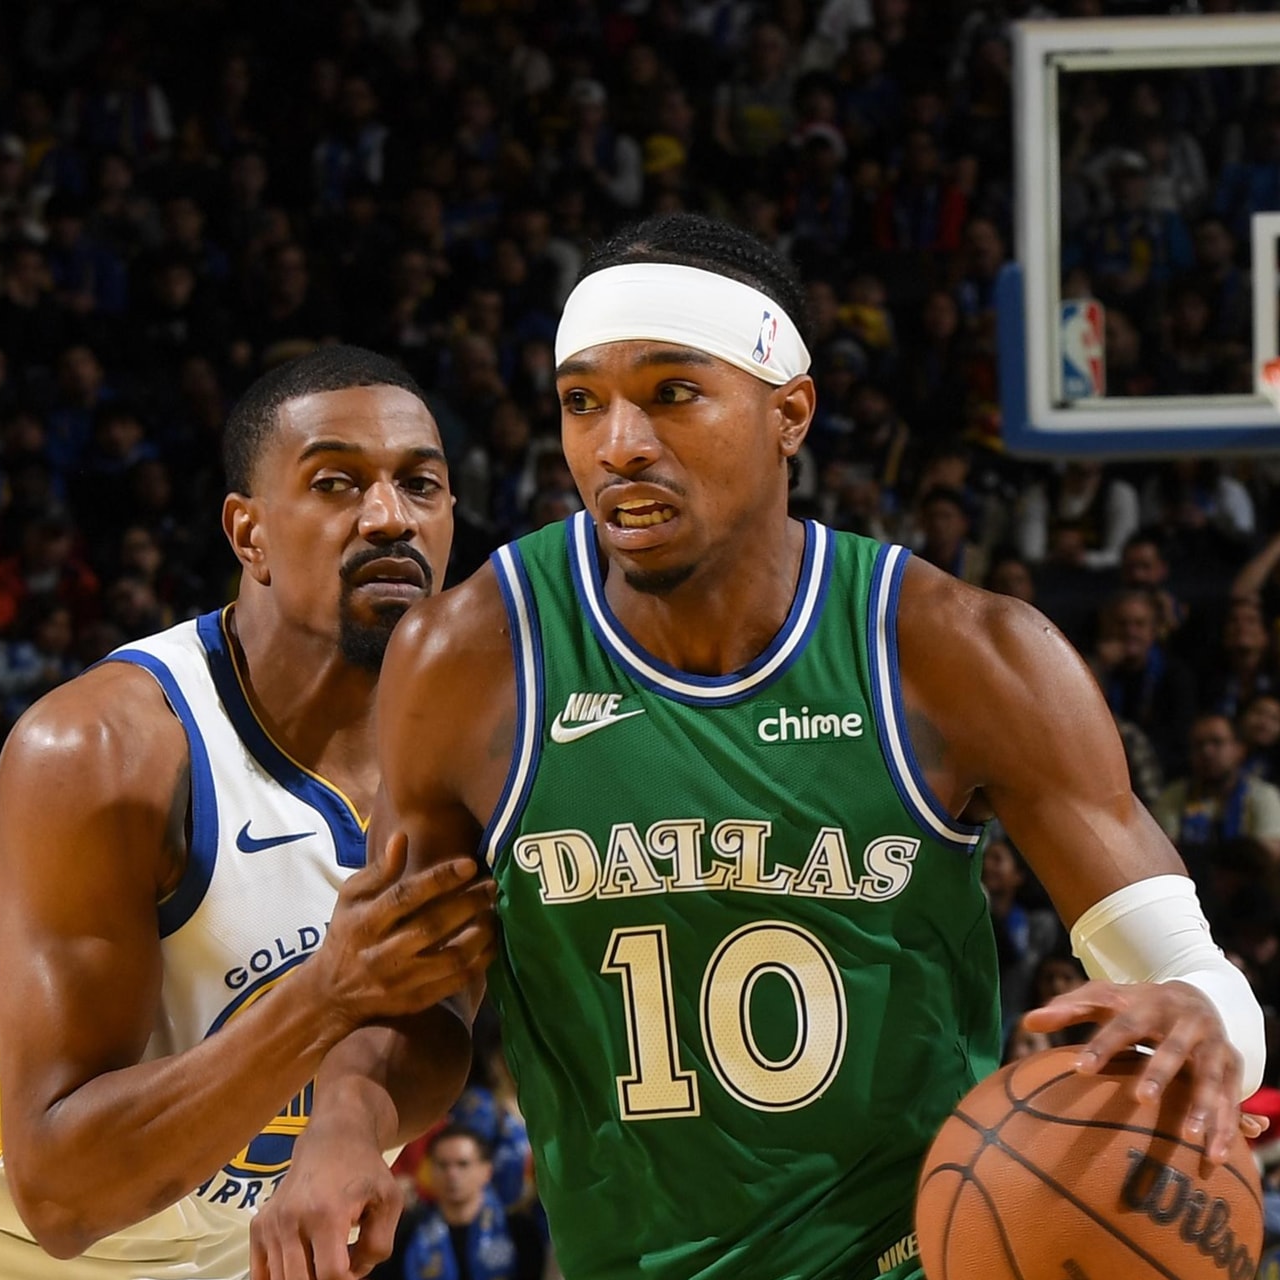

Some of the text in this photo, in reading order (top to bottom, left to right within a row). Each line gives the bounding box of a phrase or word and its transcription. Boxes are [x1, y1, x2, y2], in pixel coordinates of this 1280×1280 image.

[562, 692, 623, 722] NIKE
[758, 707, 863, 742] chime
[514, 819, 920, 904] DALLAS
[224, 921, 331, 989] GOLD
[601, 920, 848, 1120] 10
[877, 1231, 921, 1275] NIKE
